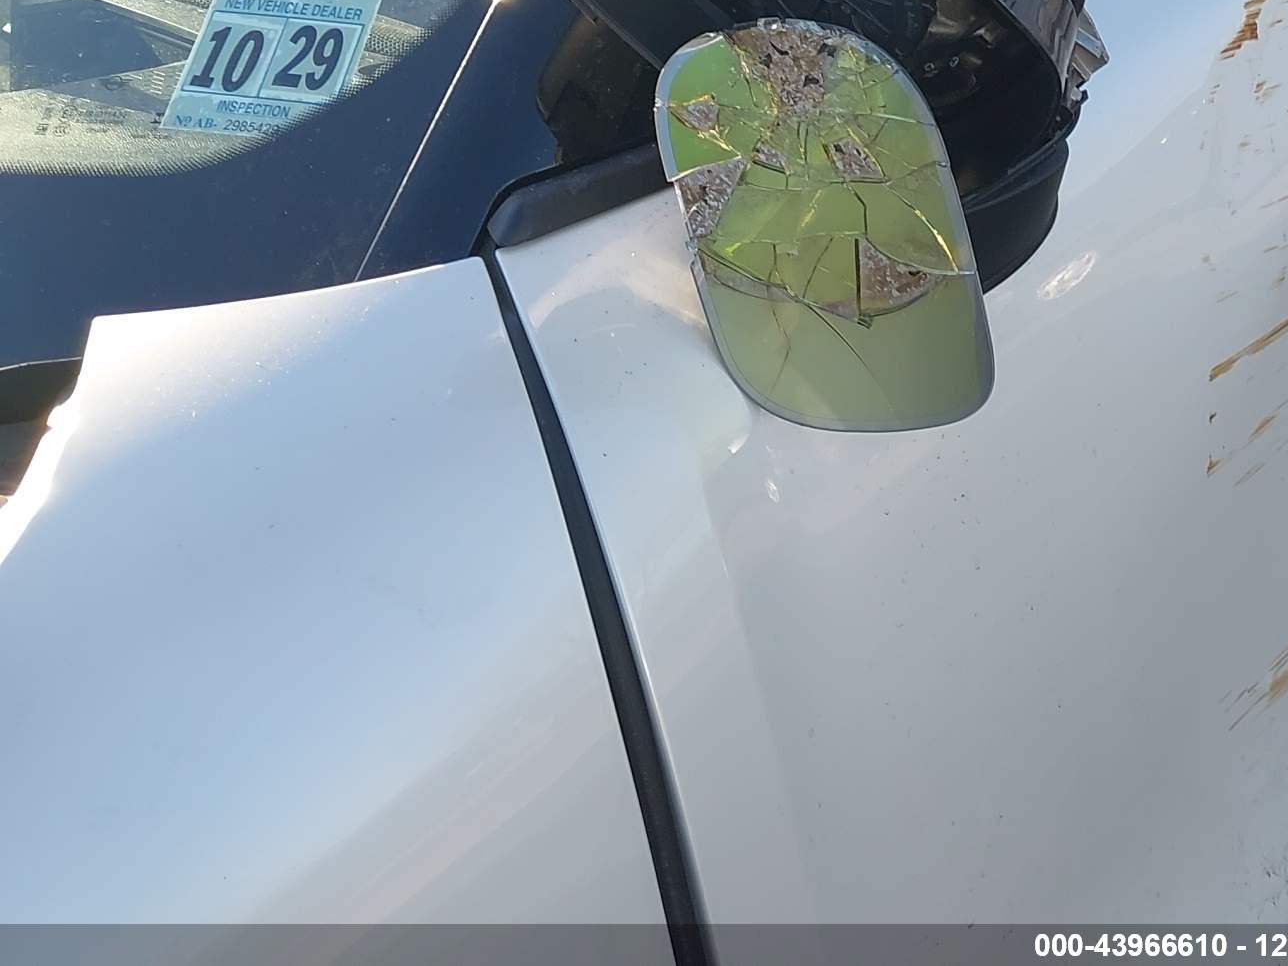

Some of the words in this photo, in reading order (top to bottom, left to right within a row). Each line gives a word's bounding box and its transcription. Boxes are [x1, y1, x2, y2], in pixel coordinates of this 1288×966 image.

[257, 0, 309, 16] VEHICLE
[311, 4, 363, 21] DEALER
[190, 26, 265, 93] 10
[272, 25, 345, 91] 29
[216, 100, 291, 117] INSPECTION
